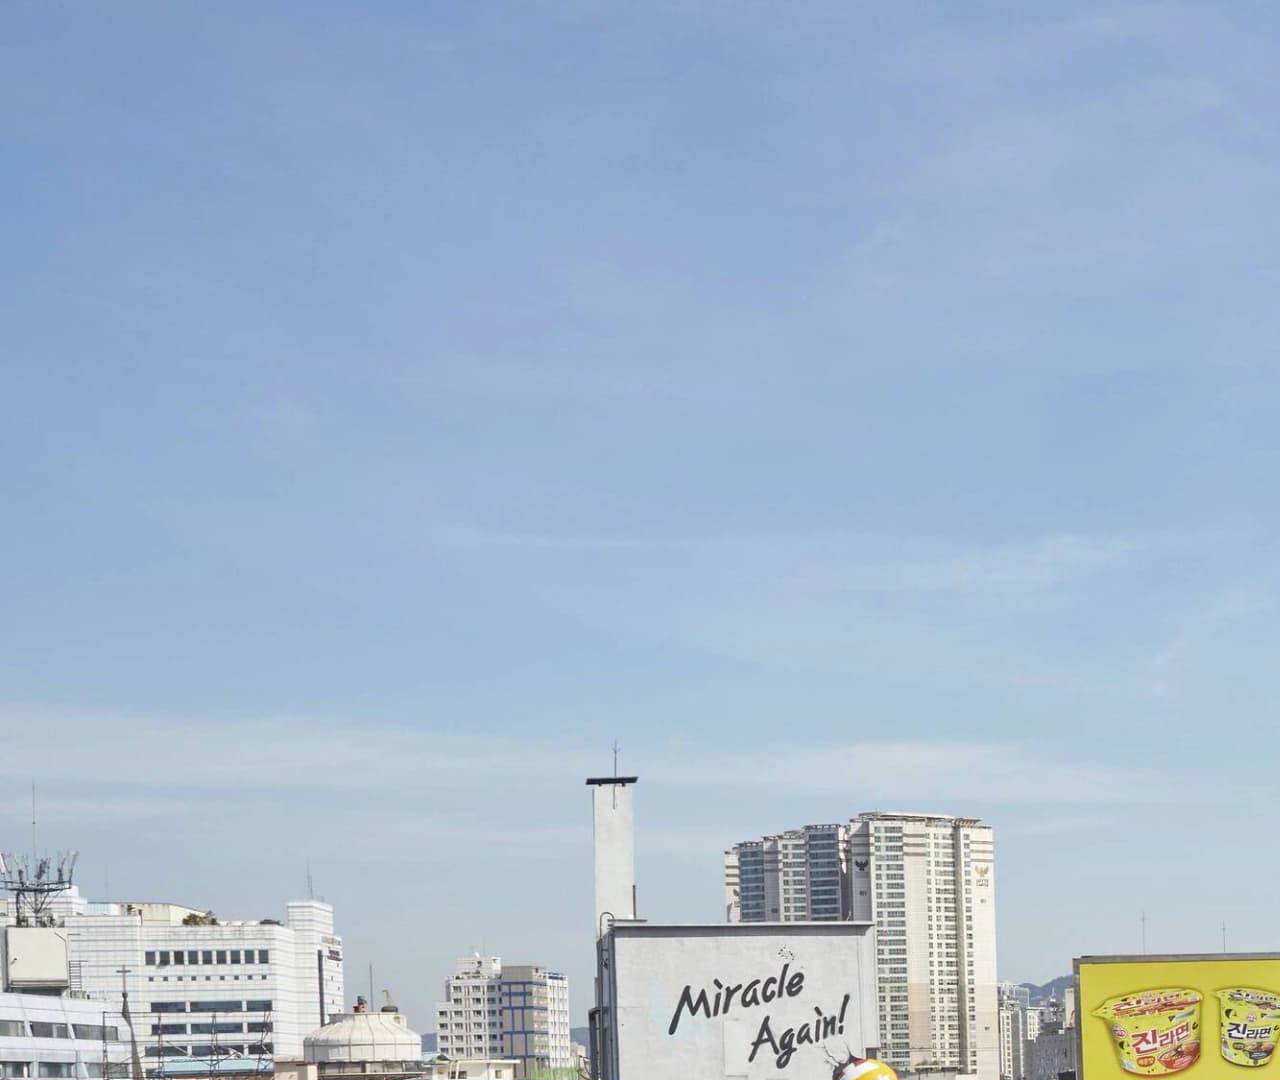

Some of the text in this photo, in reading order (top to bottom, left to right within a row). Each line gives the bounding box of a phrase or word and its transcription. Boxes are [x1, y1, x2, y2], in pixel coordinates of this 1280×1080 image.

[668, 962, 805, 1036] Miracle
[748, 994, 851, 1070] Again!
[1131, 1022, 1190, 1054] 진라면
[1227, 1022, 1271, 1040] 진라면
